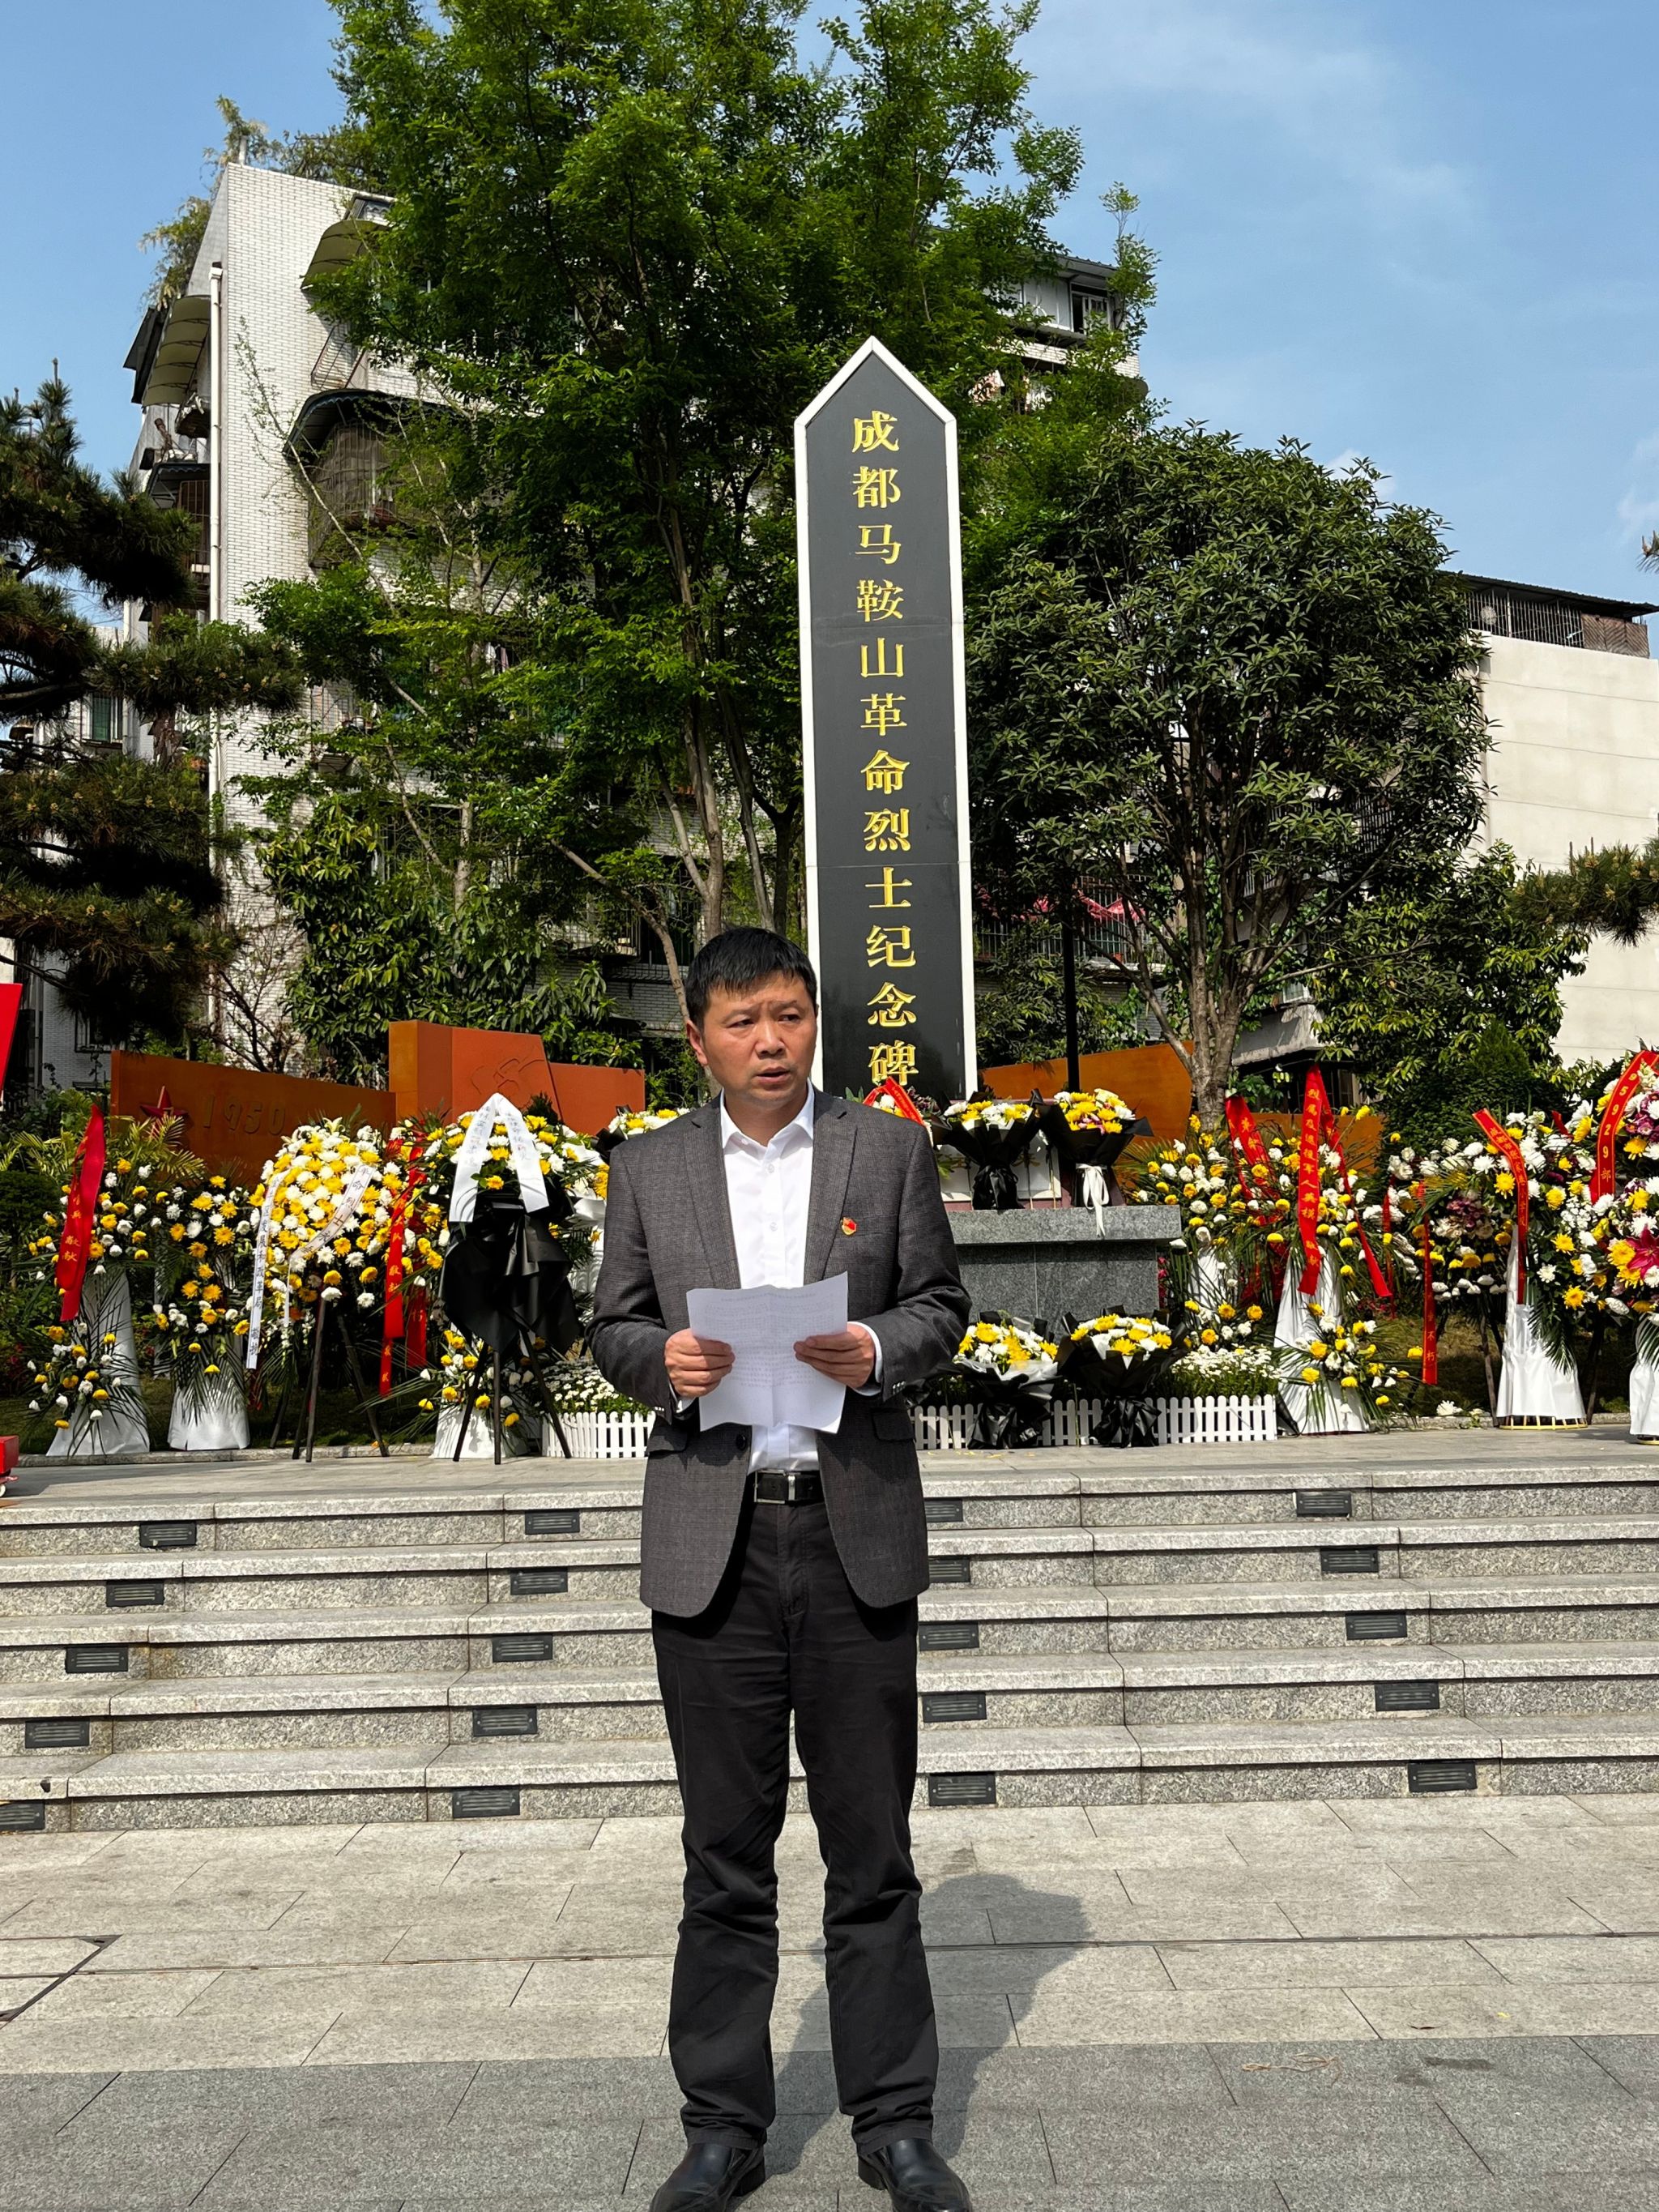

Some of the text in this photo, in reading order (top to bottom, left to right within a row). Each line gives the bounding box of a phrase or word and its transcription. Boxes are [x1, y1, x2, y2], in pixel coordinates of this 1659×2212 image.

[851, 410, 919, 1087] 成都马鞍山革命烈士纪念碑
[201, 1095, 286, 1136] 1950
[1601, 1073, 1638, 1182] 95929部
